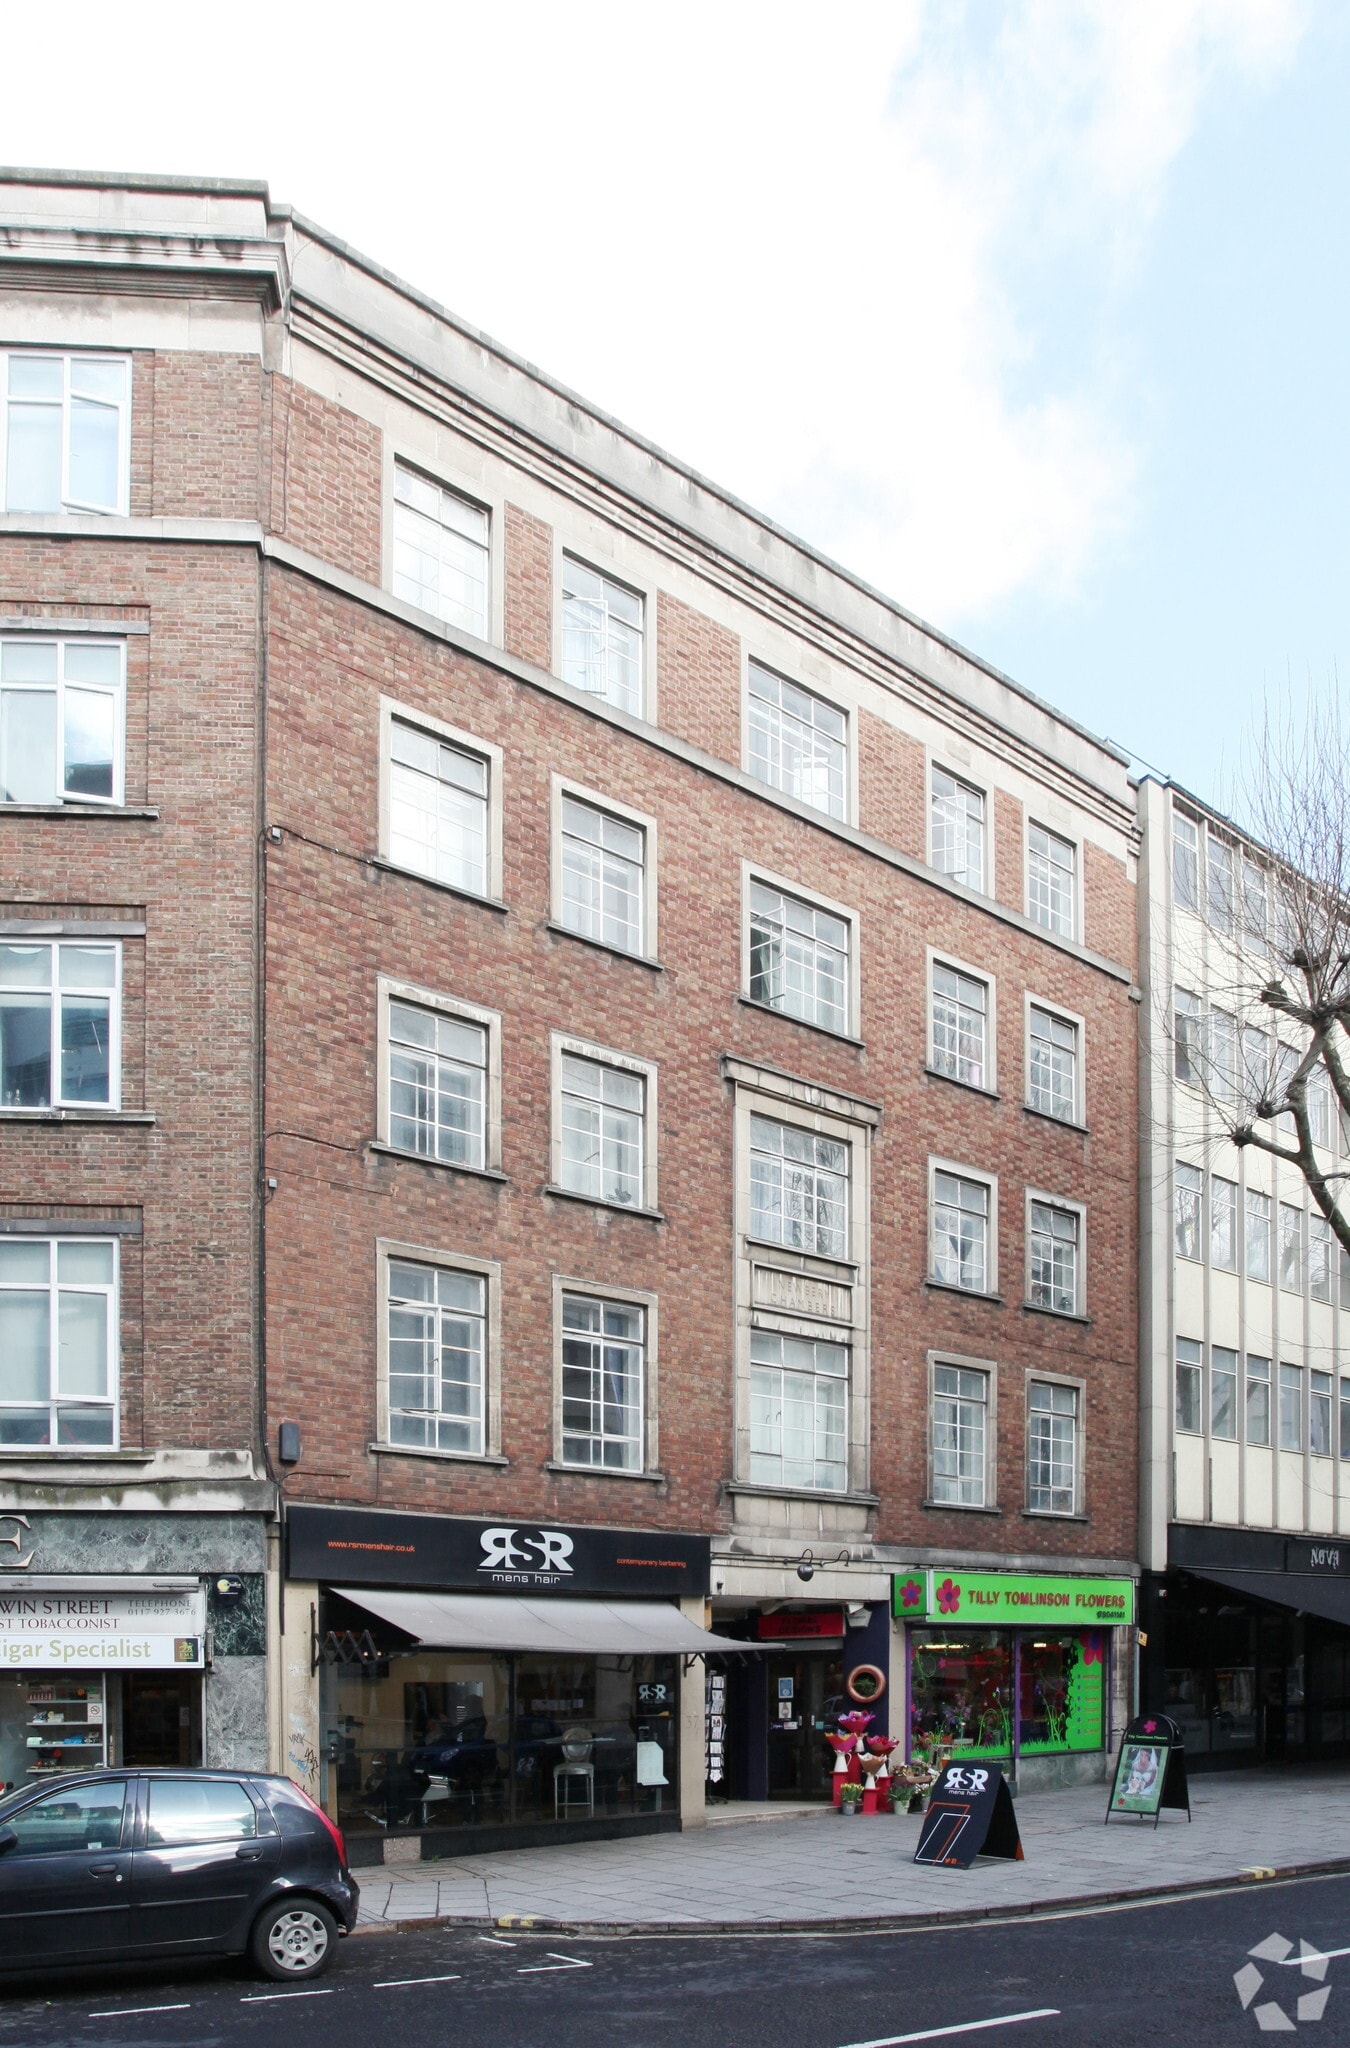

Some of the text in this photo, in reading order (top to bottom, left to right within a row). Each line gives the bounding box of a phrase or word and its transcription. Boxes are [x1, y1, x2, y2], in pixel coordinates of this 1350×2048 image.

[770, 1293, 836, 1317] CHAMBERS
[327, 1541, 416, 1552] www.rsrmenshair.co.uk
[616, 1558, 687, 1568] contemporary barbering
[492, 1574, 561, 1584] mens hair
[127, 1599, 192, 1608] TELEPHONE
[968, 1590, 1126, 1609] TILLY TOMLINSON FLOWERS
[0, 1599, 113, 1614] WIN STREET
[127, 1608, 197, 1616] 0117 927 3676
[18, 1618, 120, 1629] TOBACCONIST
[0, 1638, 151, 1663] igar Specialist
